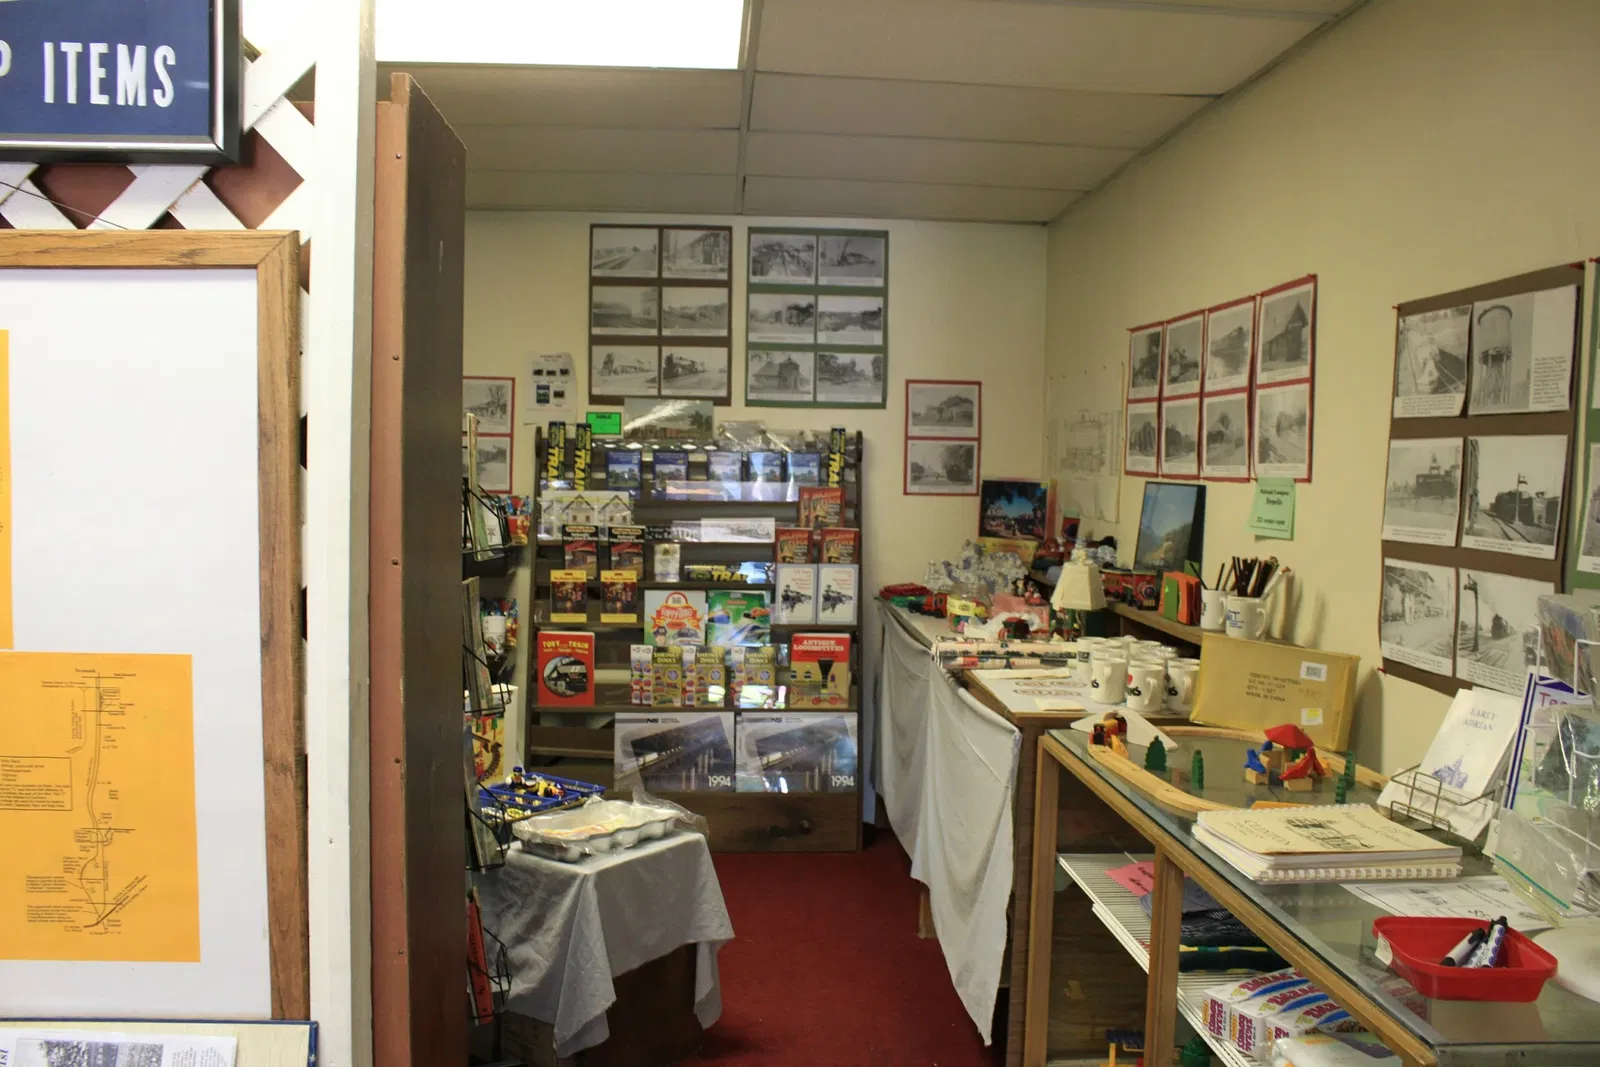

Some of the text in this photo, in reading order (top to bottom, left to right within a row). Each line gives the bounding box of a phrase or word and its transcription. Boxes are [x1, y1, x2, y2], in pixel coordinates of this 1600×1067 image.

[44, 42, 176, 108] ITEMS
[1469, 706, 1499, 721] EARLY
[1463, 719, 1495, 732] ADRIAN
[708, 775, 732, 788] 1994
[831, 775, 855, 788] 1994
